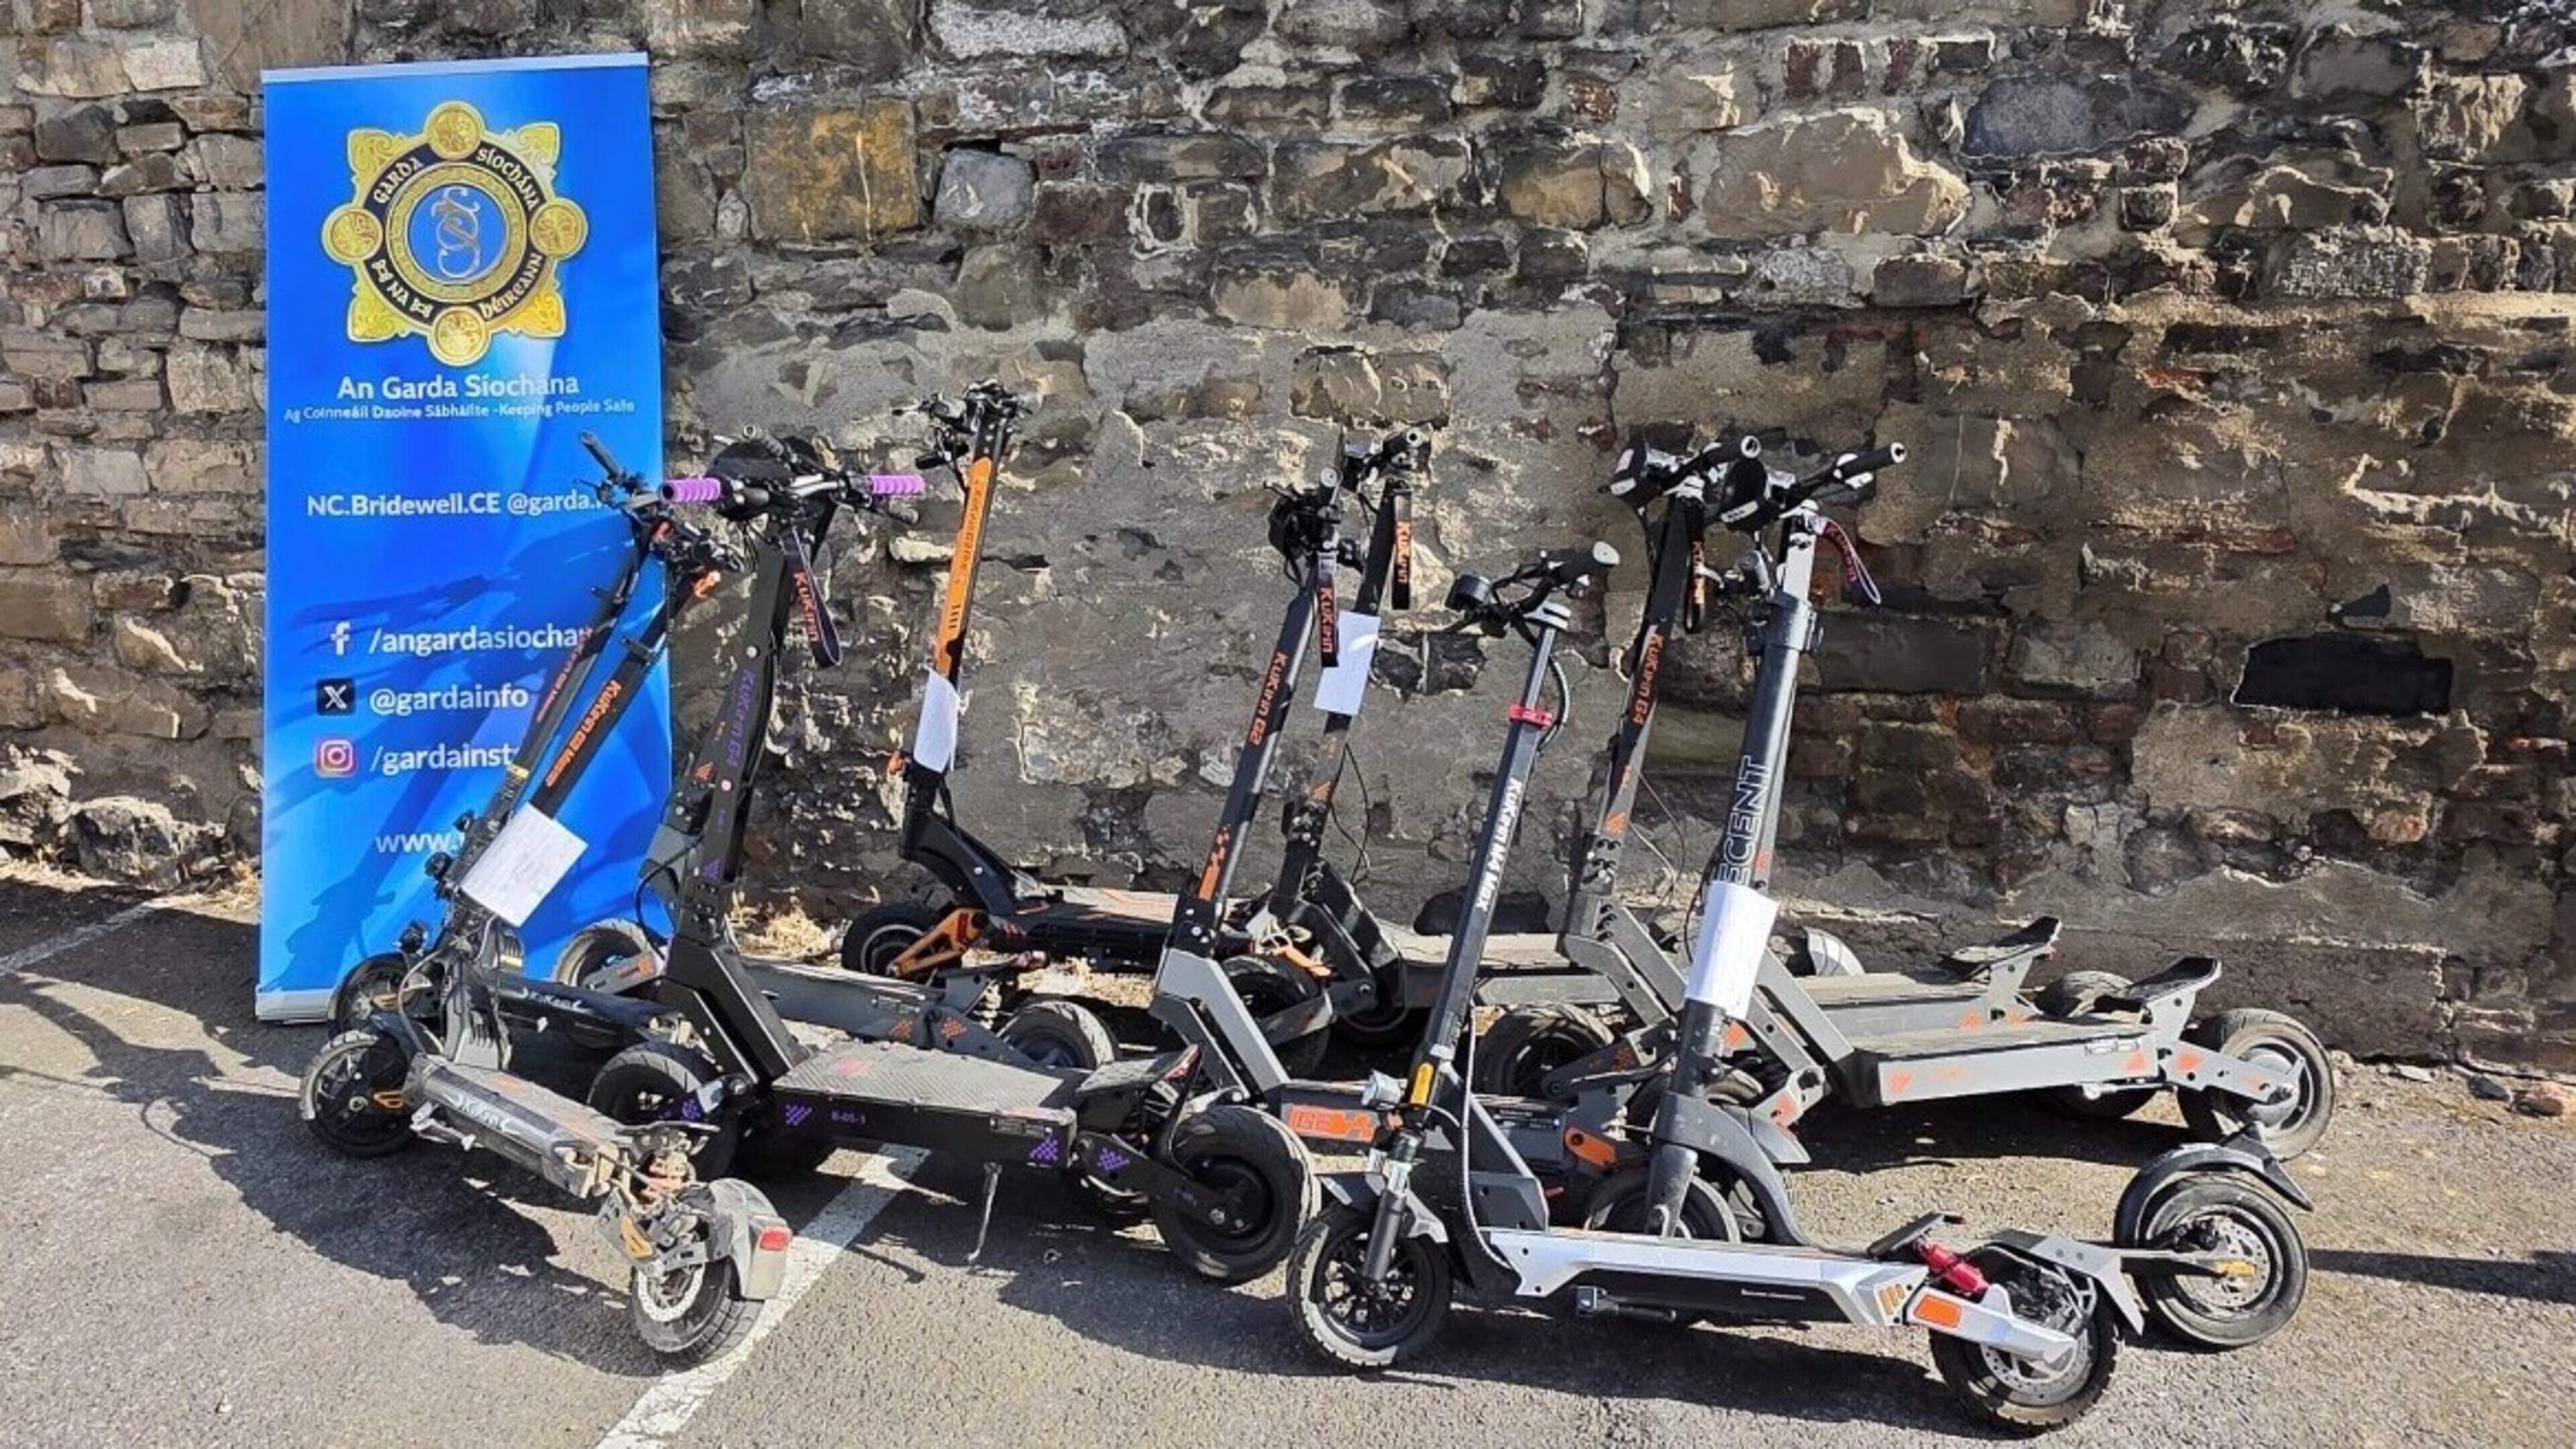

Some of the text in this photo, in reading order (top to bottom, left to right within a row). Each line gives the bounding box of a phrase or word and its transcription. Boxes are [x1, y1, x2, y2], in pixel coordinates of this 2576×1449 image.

[337, 373, 580, 399] An Garda Síochána
[284, 409, 300, 423] Ag
[303, 405, 368, 419] Coinneáil
[372, 405, 422, 419] Daoine
[555, 400, 600, 415] People
[604, 398, 635, 413] Safe
[307, 492, 500, 516] NC.Bridewell.CE
[1320, 587, 1333, 653] KuKirin
[1639, 633, 1665, 697] KuKirin
[369, 682, 529, 716] @gardainfo
[1257, 651, 1289, 717] KuKirin
[370, 743, 521, 775] /gardainst
[1476, 777, 1523, 913] KuKirin M4 Max
